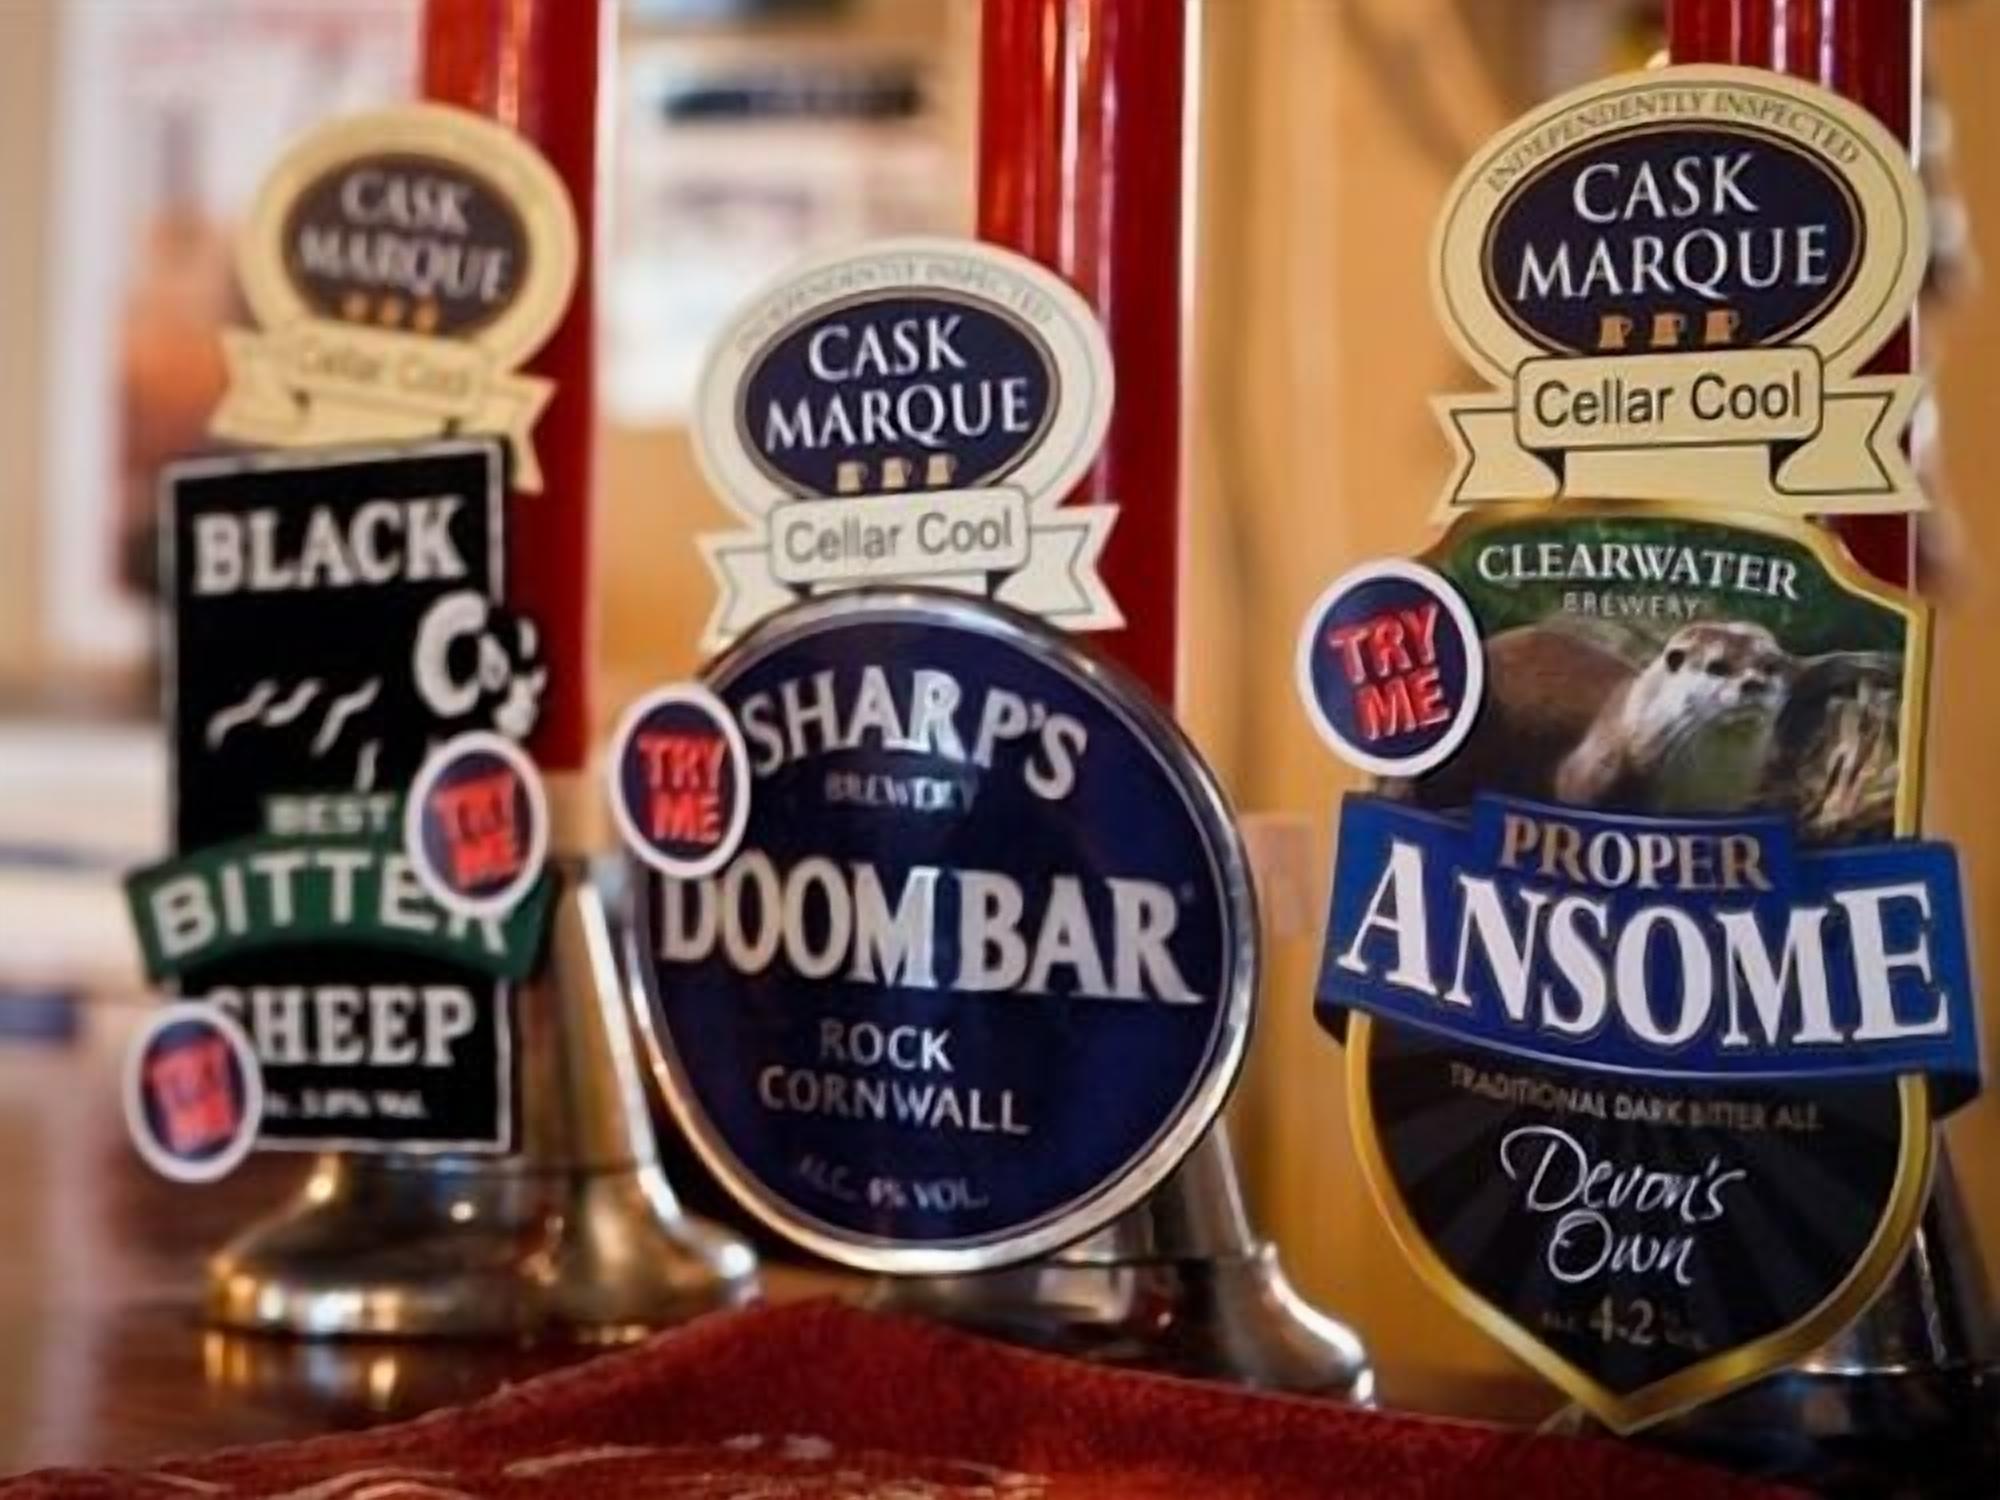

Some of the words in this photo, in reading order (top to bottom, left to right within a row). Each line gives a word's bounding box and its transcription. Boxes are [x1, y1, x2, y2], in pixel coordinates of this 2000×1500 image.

[1485, 90, 1701, 193] INDEPENDENTLY
[1712, 89, 1861, 165] INSPECTED
[341, 170, 476, 235] CASK
[1572, 152, 1759, 224] CASK
[300, 225, 512, 302] MARQUE
[1517, 224, 1828, 301] MARQUE
[807, 314, 966, 381] CASK
[764, 377, 1030, 451] MARQUE
[1534, 379, 1674, 428] Cellar
[1689, 371, 1800, 422] Cool
[193, 498, 468, 595] BLACK
[784, 515, 902, 564] Cellar
[916, 508, 1013, 554] Cool
[1477, 542, 1800, 601] CLEARWATER
[1562, 591, 1699, 618] BREWERY
[1329, 599, 1442, 684] TRY
[741, 664, 1088, 800] SHARP'S
[1355, 666, 1450, 742] ME
[638, 731, 727, 791] TRY
[266, 794, 394, 834] BEST
[653, 793, 721, 843] ME
[1500, 813, 1773, 892] PROPER
[660, 848, 940, 988] DOOM
[955, 868, 1204, 1005] BAR
[1337, 836, 1950, 1048] ANSOME
[819, 1019, 954, 1073] ROCK
[757, 1064, 1031, 1135] CORNWALL
[1450, 1062, 1607, 1120] TRADITIONAL
[1614, 1094, 1680, 1125] DARK
[1500, 1124, 1748, 1224] Devon's
[1547, 1209, 1695, 1287] Own
